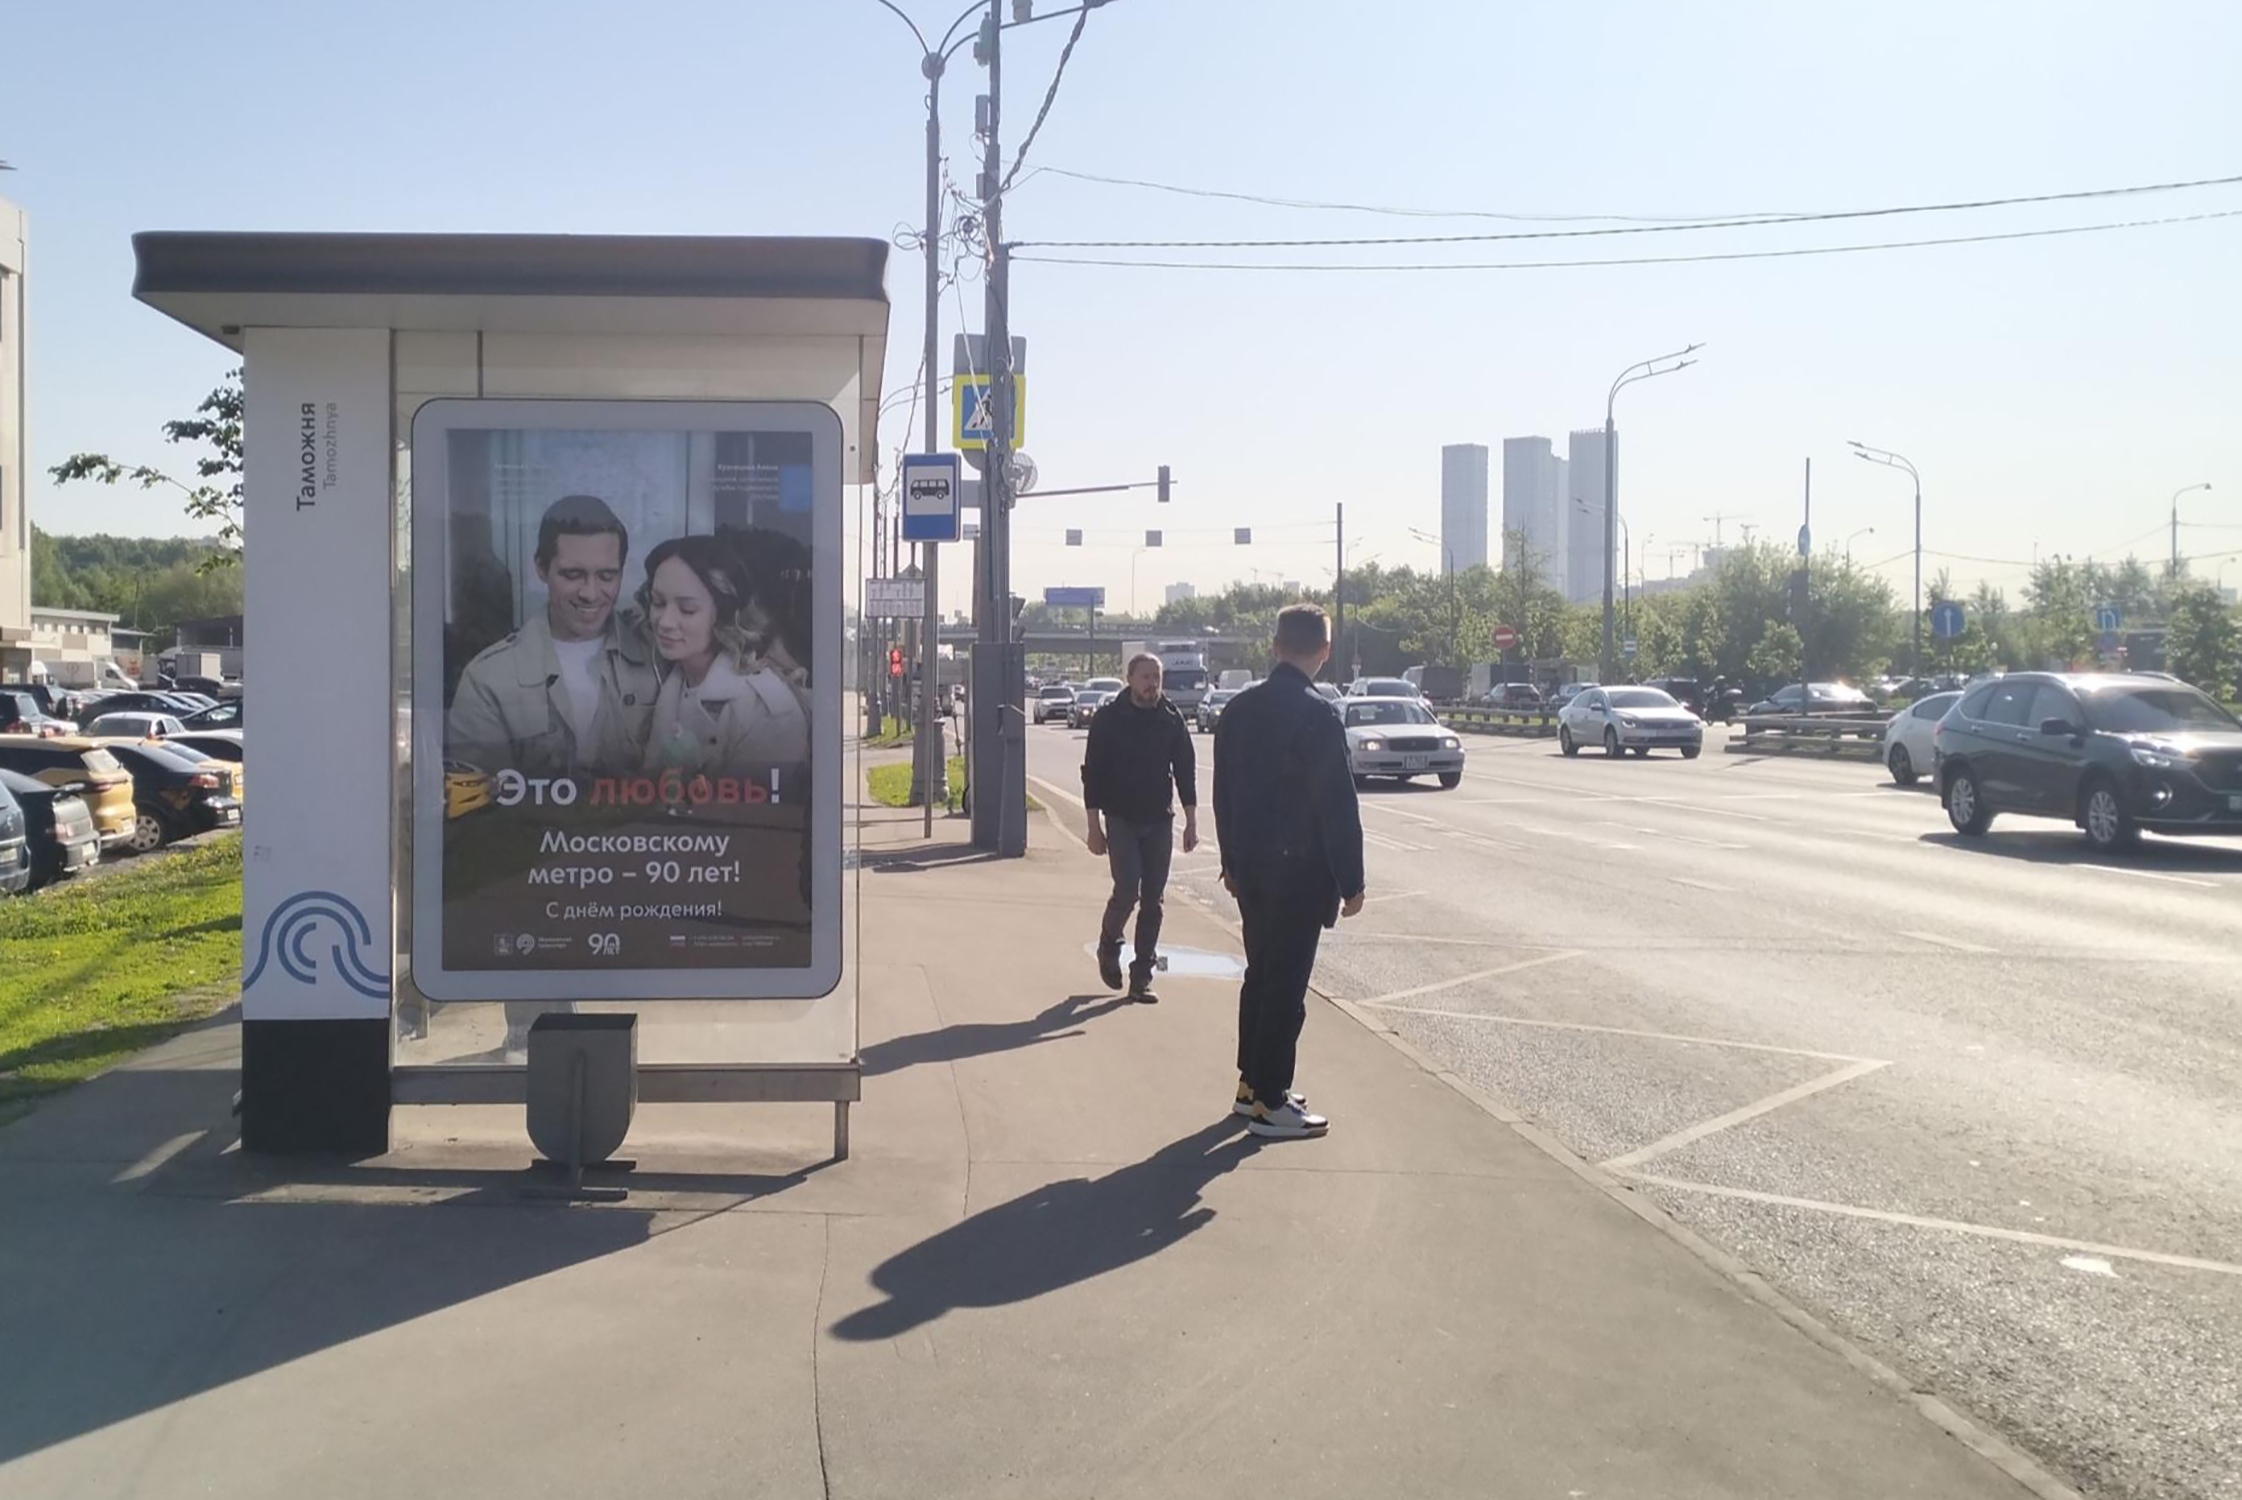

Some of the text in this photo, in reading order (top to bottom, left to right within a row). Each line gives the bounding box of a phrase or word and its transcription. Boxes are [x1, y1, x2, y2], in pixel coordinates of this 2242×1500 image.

[297, 403, 315, 511] Таможня
[323, 403, 338, 490] Tamozhnya
[497, 768, 780, 805] Это любовь!
[540, 831, 729, 856] Московскому
[528, 864, 613, 888] метро
[646, 862, 680, 882] 90
[688, 861, 740, 882] лет!
[546, 901, 721, 921] С днём рождения!
